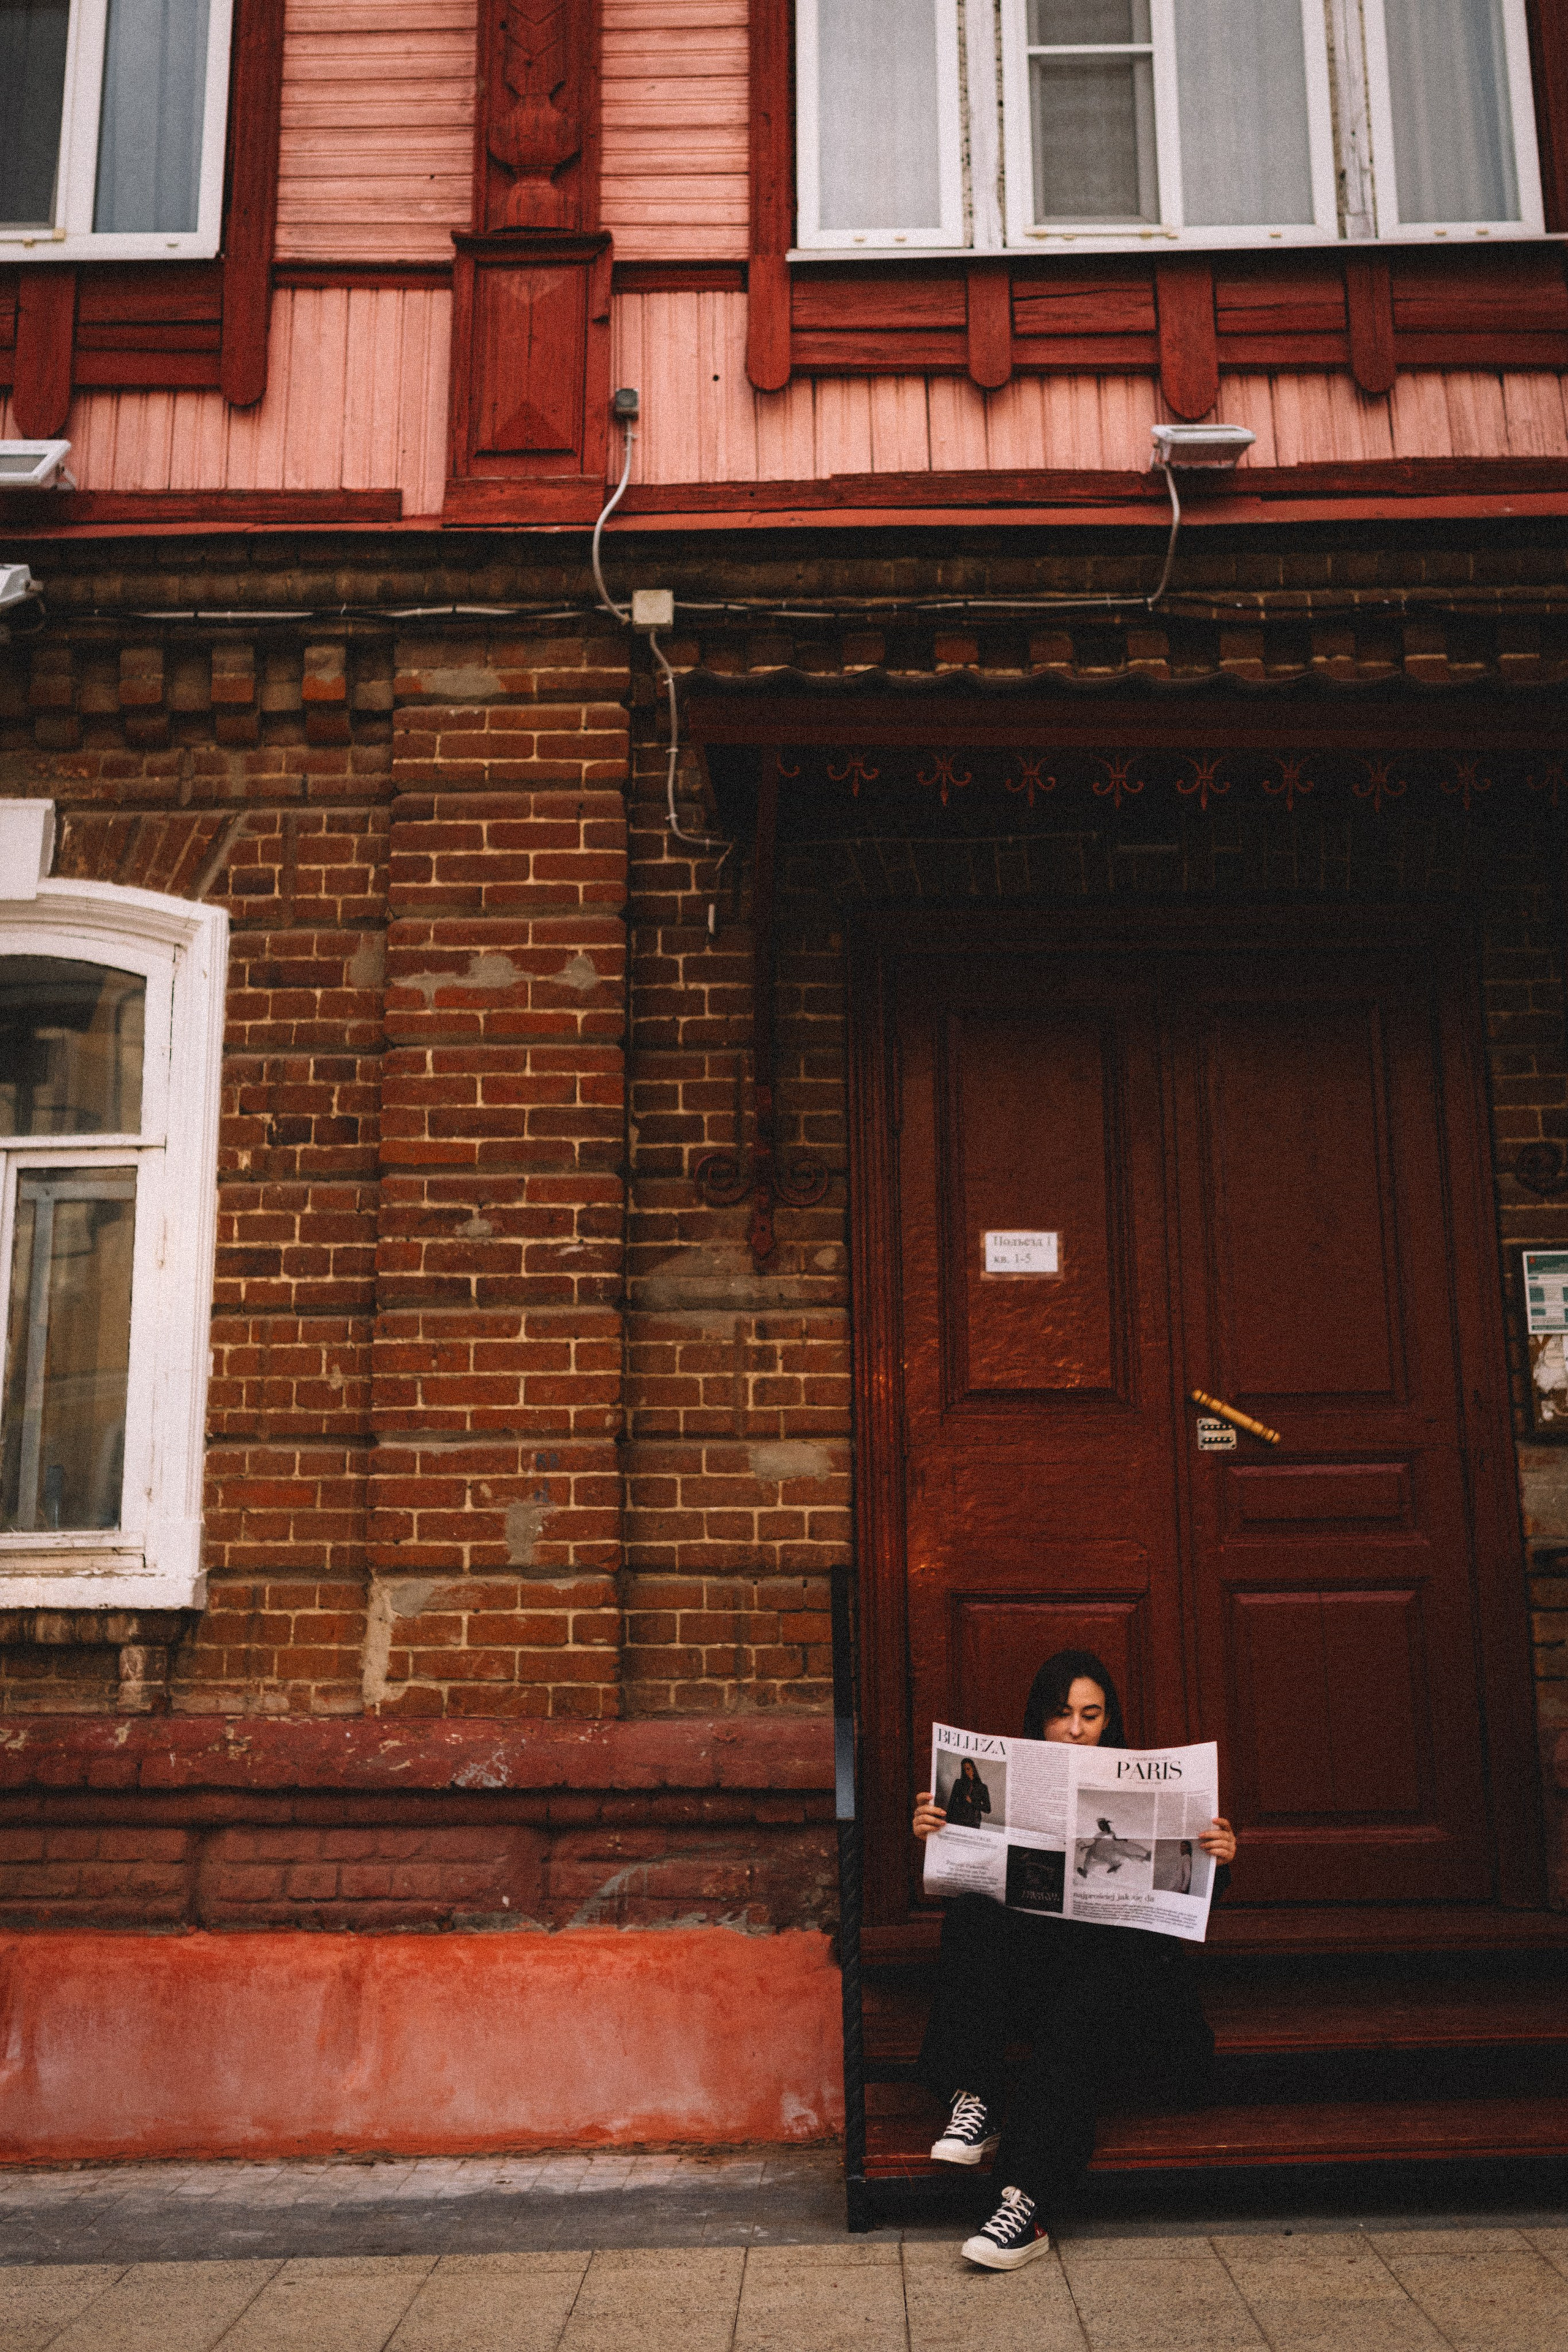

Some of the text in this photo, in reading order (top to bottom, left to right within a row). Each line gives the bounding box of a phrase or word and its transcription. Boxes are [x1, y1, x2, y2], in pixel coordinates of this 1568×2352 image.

[1014, 1253, 1031, 1264] 1-5
[938, 1728, 1006, 1755] BELLEZA
[1115, 1761, 1182, 1780] PARIS
[1116, 1893, 1129, 1902] jak
